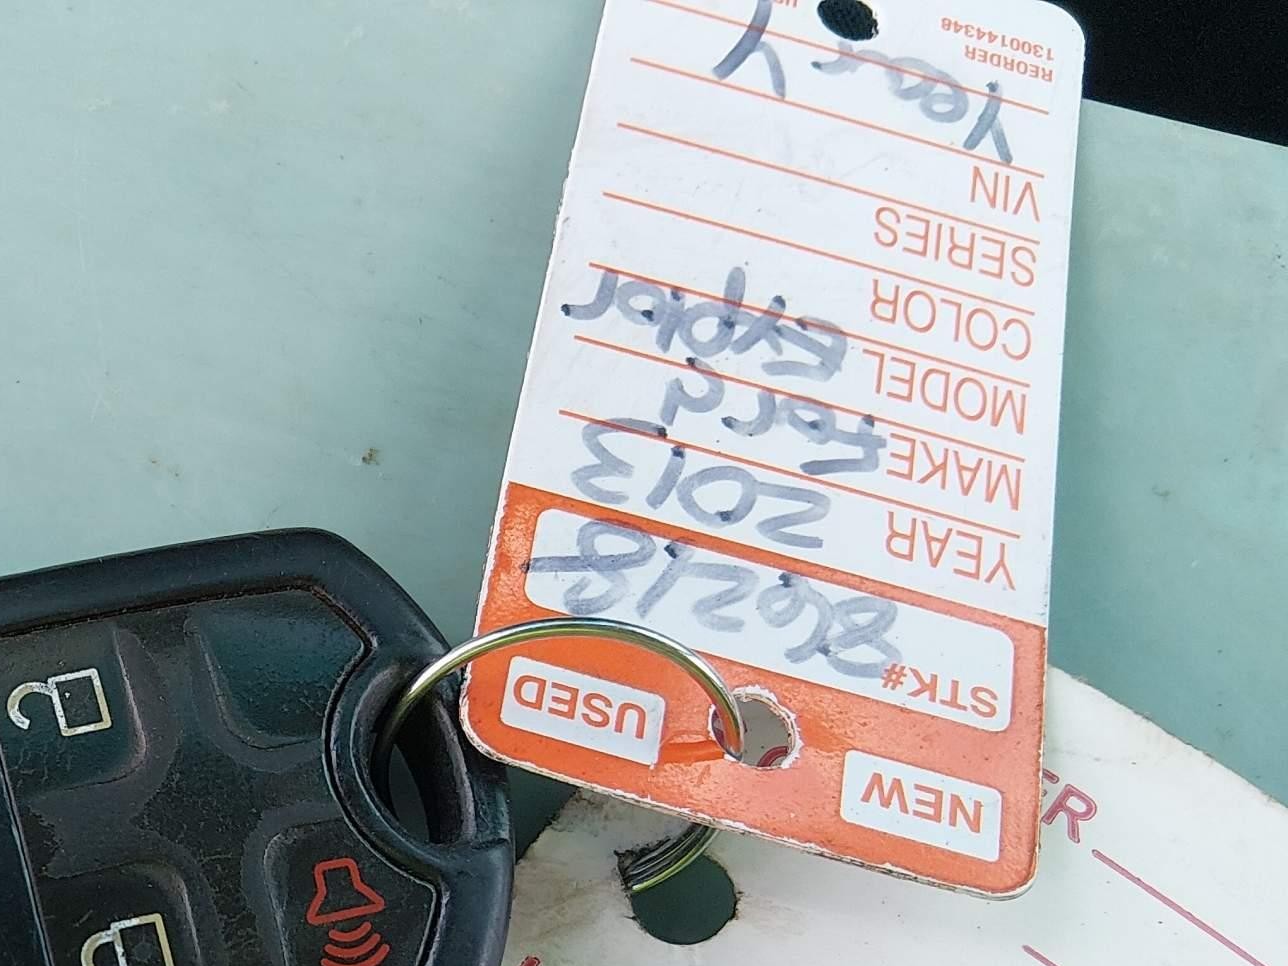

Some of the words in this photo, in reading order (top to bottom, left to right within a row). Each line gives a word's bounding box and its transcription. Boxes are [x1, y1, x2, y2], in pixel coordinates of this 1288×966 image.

[941, 16, 1055, 62] 1300144348
[964, 44, 1054, 83] REORDER
[970, 165, 1041, 223] VIN
[874, 206, 1037, 287] SERIES
[870, 278, 1031, 361] COLOR
[659, 356, 888, 475] Ford
[862, 348, 1027, 435] MODEL
[570, 416, 832, 549] 2013
[886, 432, 1022, 511] MAKE
[886, 510, 1016, 591] YEAR
[513, 673, 647, 741] USED
[880, 662, 1000, 719] STK#
[861, 771, 983, 835] NEW
